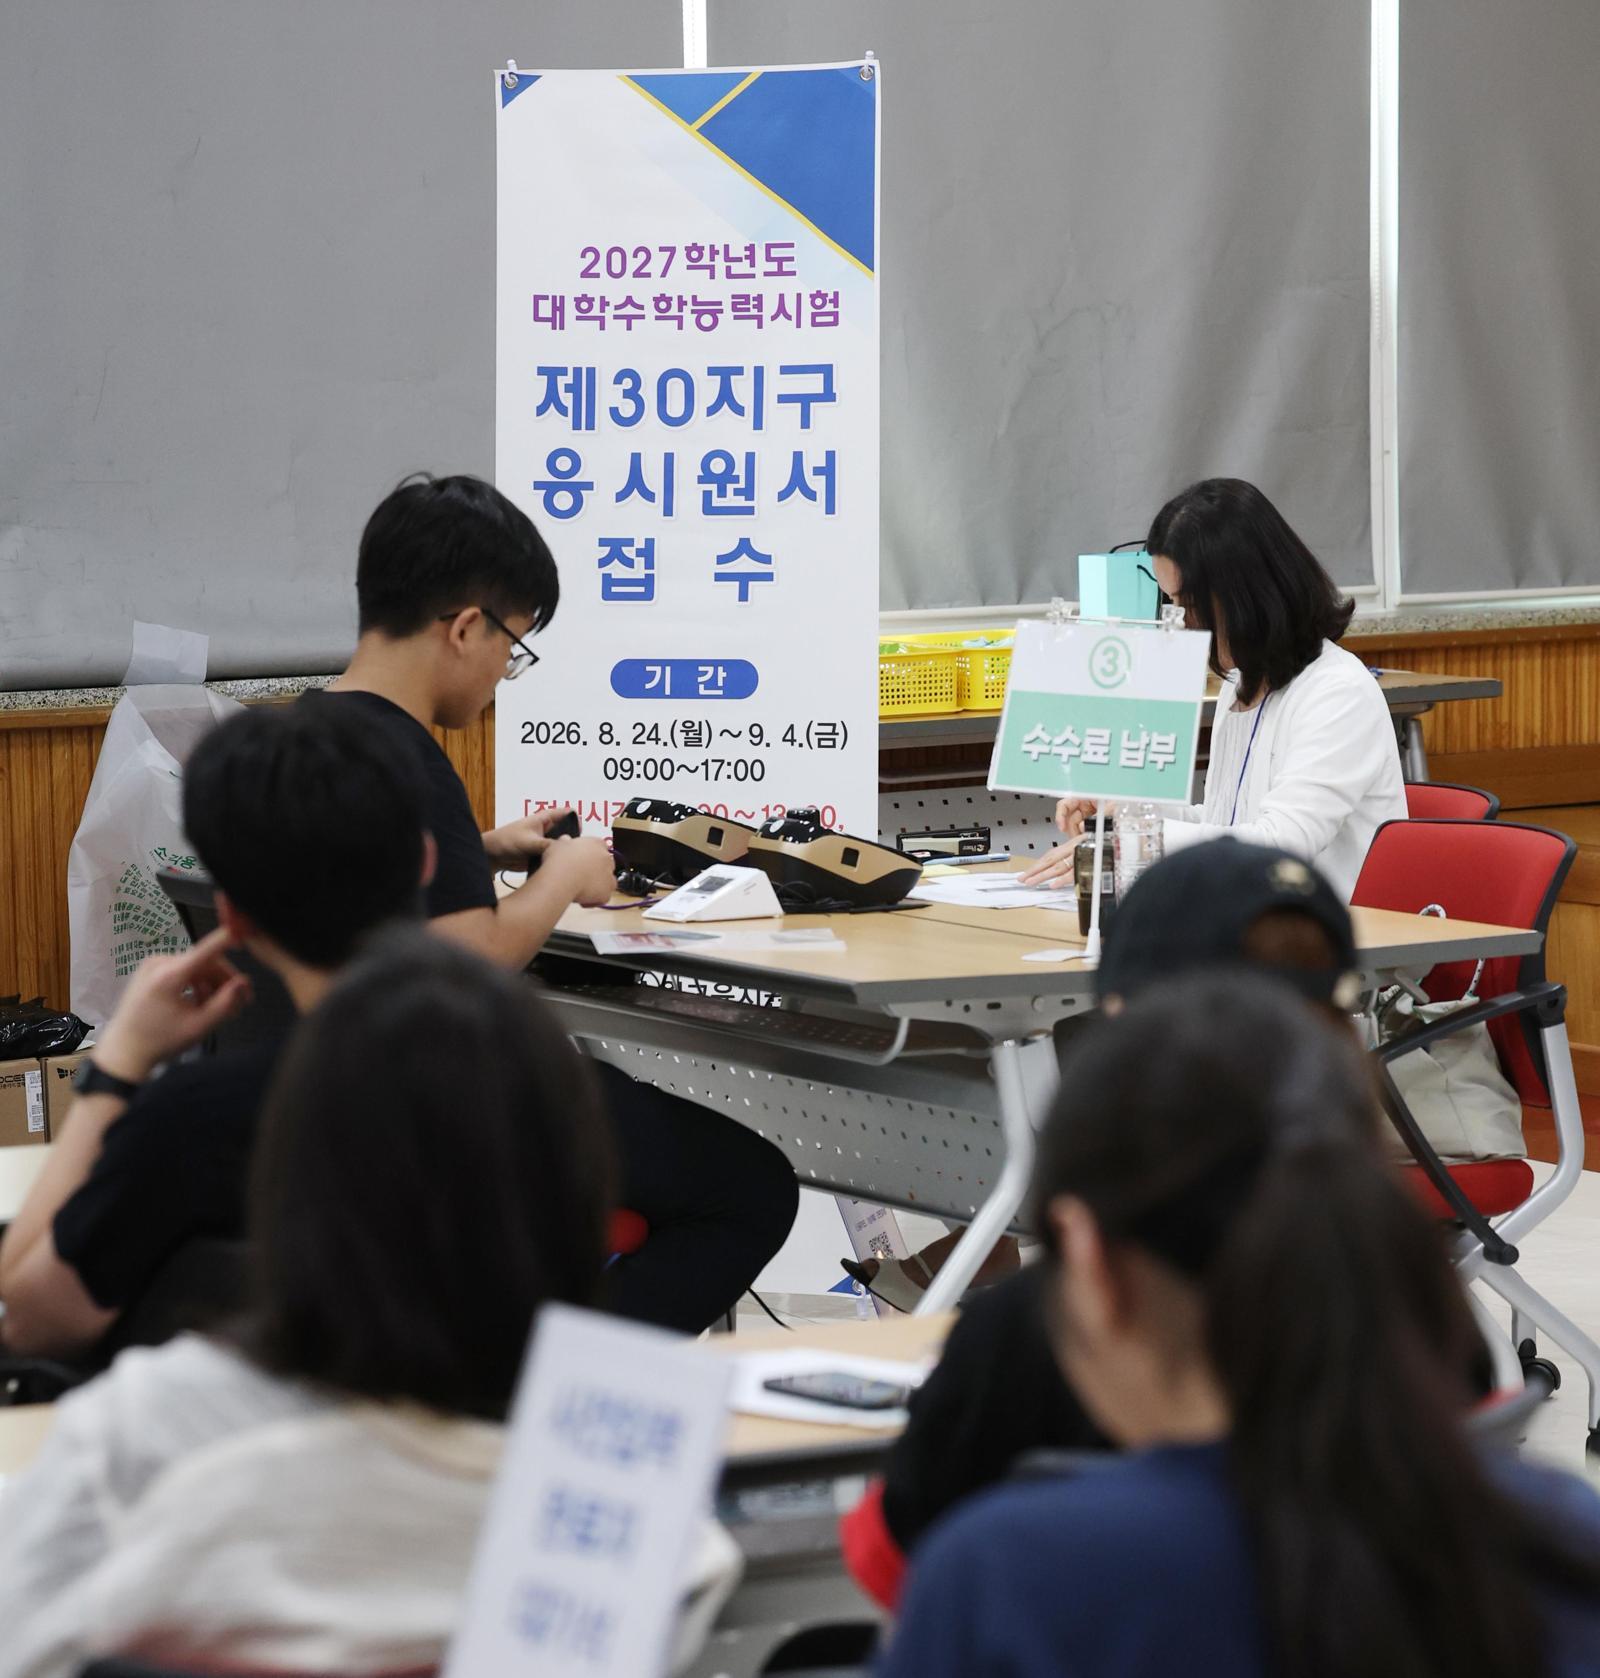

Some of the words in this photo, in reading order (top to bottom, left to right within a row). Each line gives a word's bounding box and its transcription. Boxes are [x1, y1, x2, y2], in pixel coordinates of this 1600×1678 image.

[579, 241, 797, 280] 2027학년도
[533, 290, 840, 332] 대학수학능력시험
[535, 363, 837, 431] 제30지구
[533, 447, 836, 519] 응시원서
[520, 721, 588, 746] 2026.
[598, 721, 621, 747] 8.
[781, 720, 849, 750] 4.(금)
[1021, 722, 1111, 765] 수수료
[1118, 729, 1177, 771] 납부
[603, 758, 765, 782] 09:00~17:00
